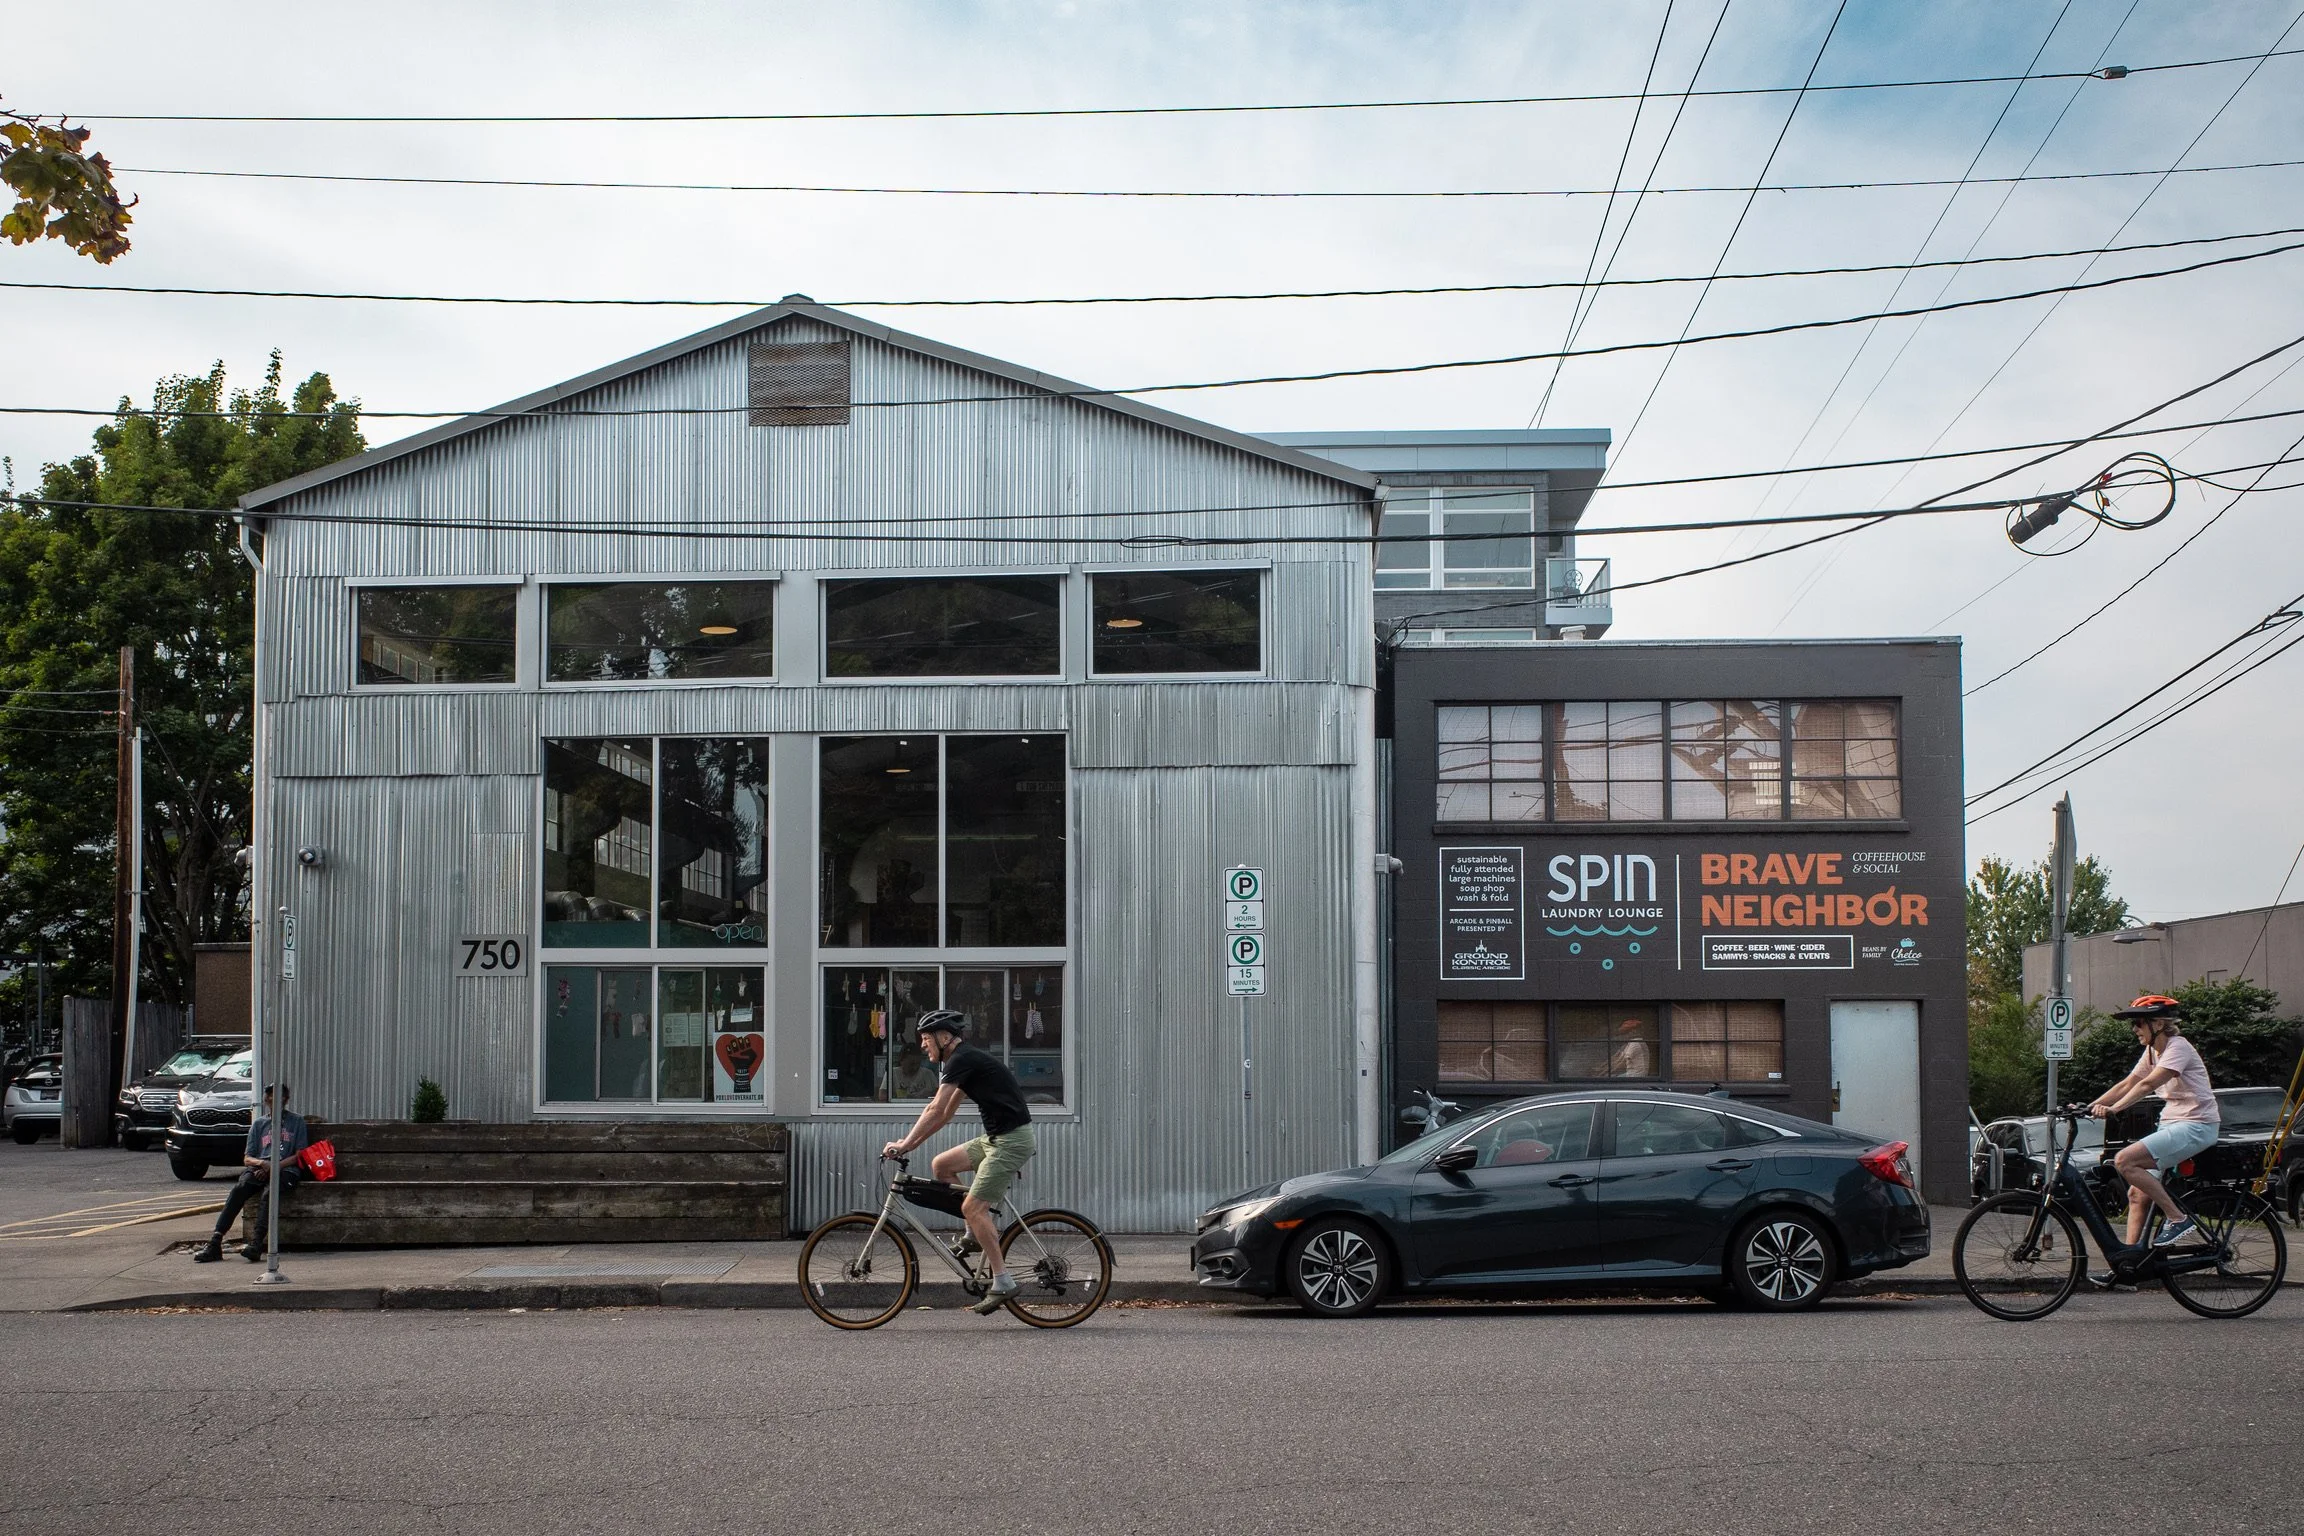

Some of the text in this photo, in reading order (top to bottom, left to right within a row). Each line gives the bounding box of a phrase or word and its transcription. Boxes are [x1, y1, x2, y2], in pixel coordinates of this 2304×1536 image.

[1457, 855, 1508, 863] sustainable
[1852, 851, 1926, 863] COFFEEHOUSE
[1450, 864, 1514, 874] fully attended
[1701, 853, 1843, 885] BRAVE
[1852, 864, 1901, 874] & SOCIAL
[1449, 874, 1516, 884] large machines
[1239, 877, 1253, 894] P
[1460, 884, 1505, 893] soap shop
[1456, 893, 1509, 901] wash & fold
[1241, 905, 1248, 914] 2
[1541, 907, 1664, 919] LAUNDRY LOUNGE
[716, 925, 763, 943] open
[1240, 941, 1254, 958] P
[1800, 943, 1825, 951] CIDER
[461, 940, 520, 970] 750
[1891, 948, 1922, 960] Chetco
[1240, 969, 1252, 978] 15
[2056, 1005, 2066, 1022] P
[2054, 1032, 2064, 1041] 15
